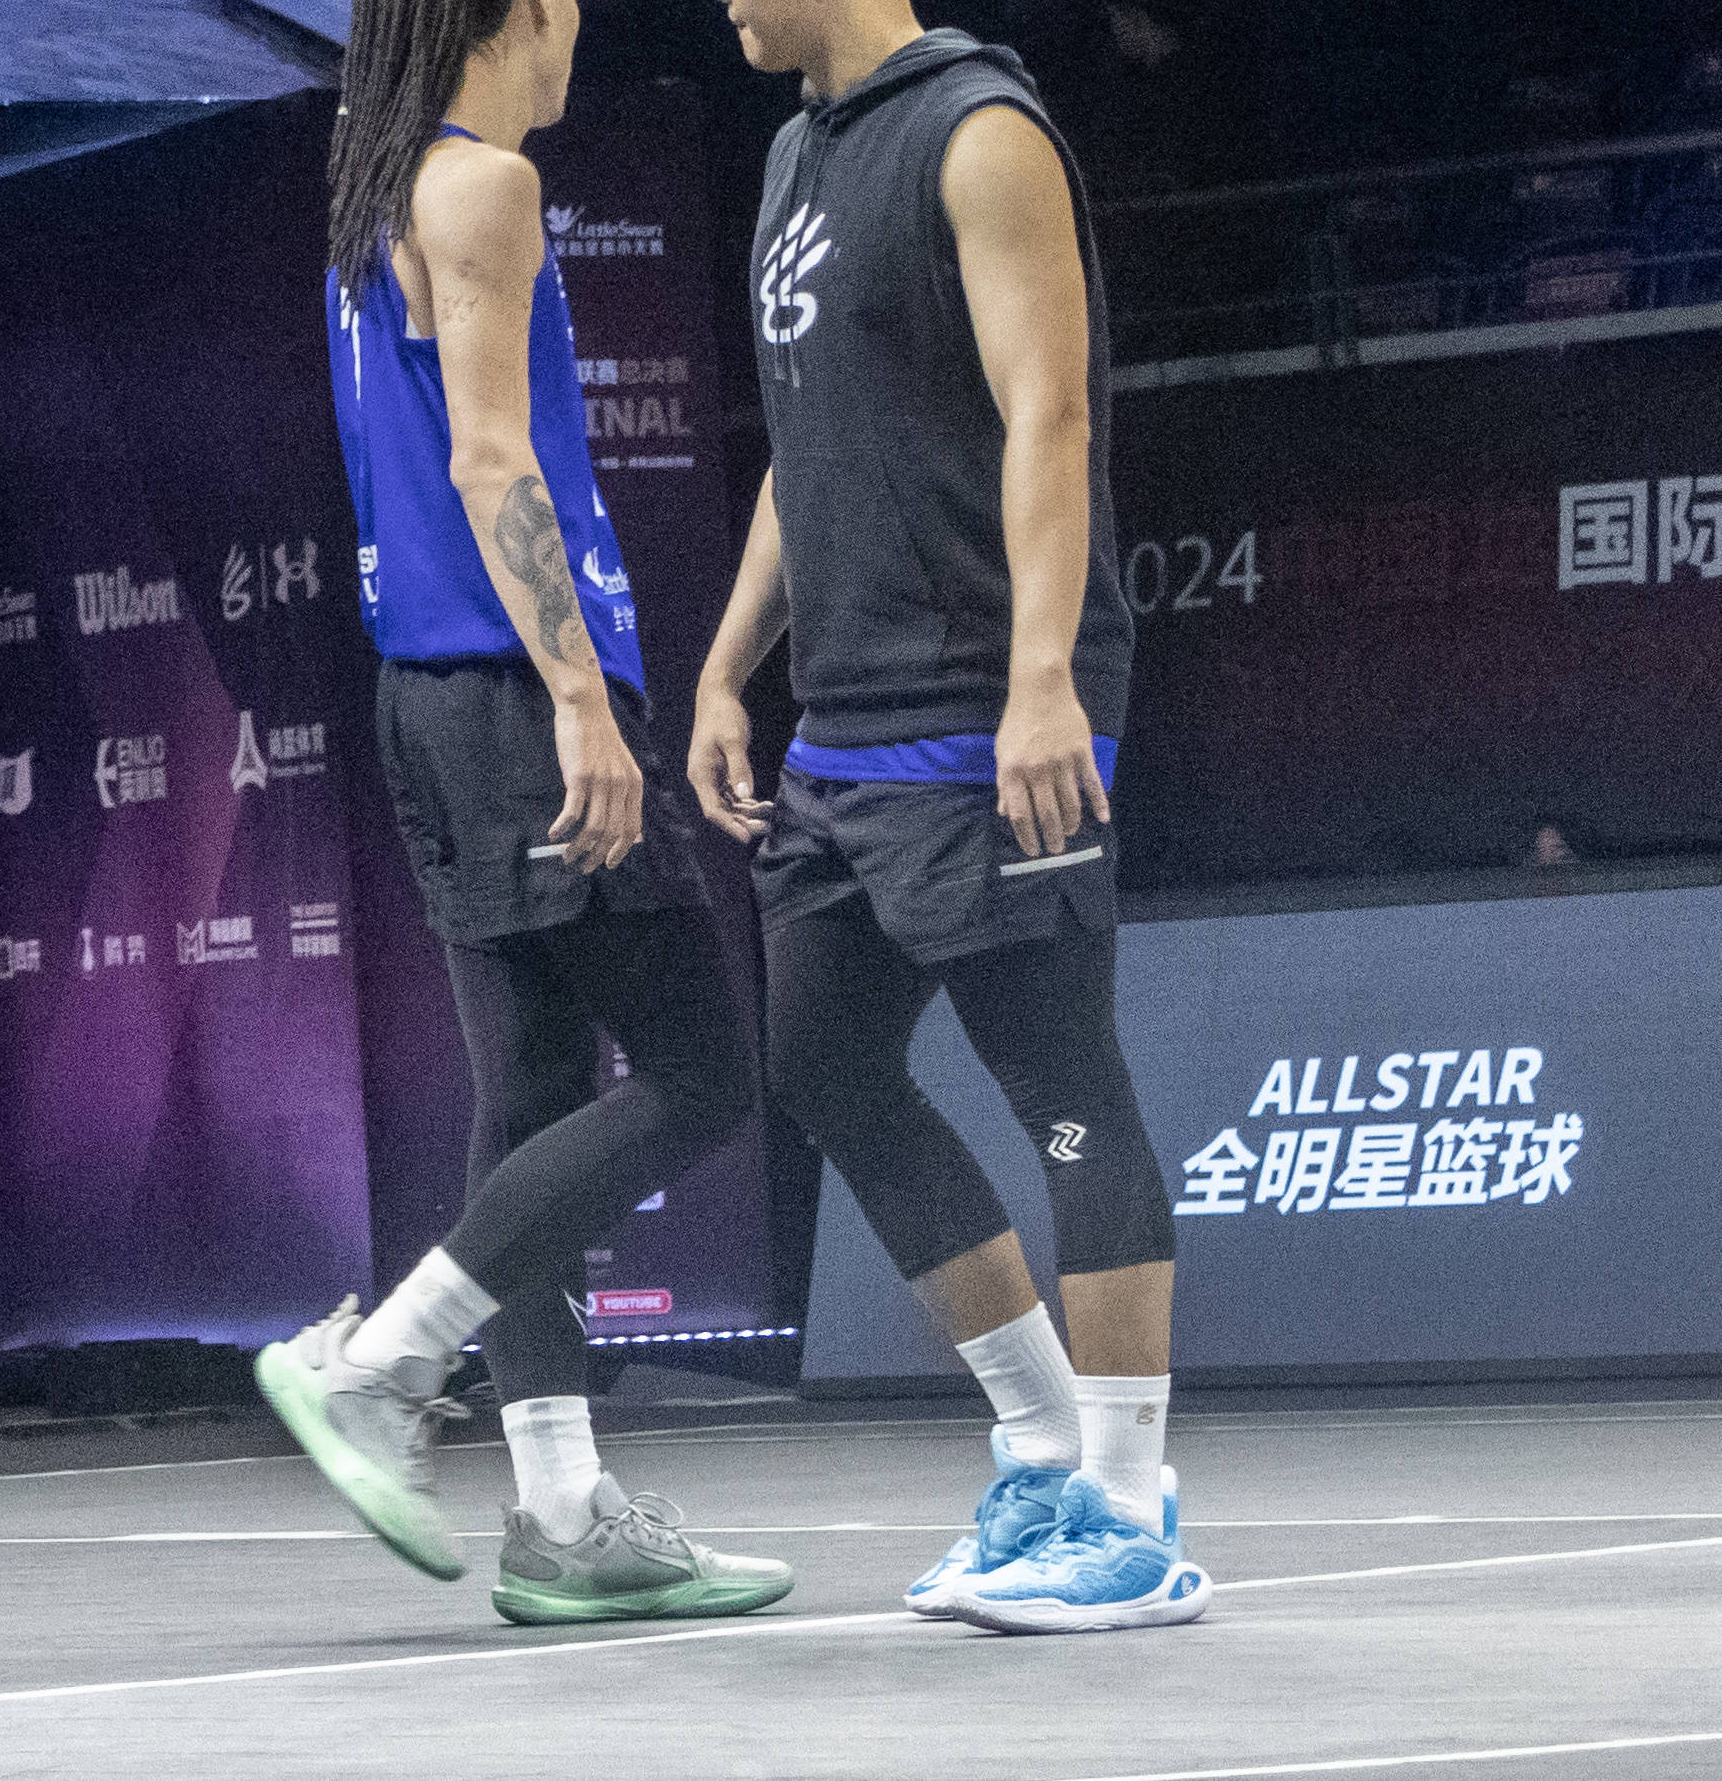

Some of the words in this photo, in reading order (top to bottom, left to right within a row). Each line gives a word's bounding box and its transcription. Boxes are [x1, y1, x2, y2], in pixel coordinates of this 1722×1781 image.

[584, 395, 694, 438] INAL
[1557, 473, 1722, 590] 国际
[73, 564, 183, 637] Wilson
[1123, 530, 1265, 616] 024
[1247, 1045, 1544, 1117] ALLSTAR
[1171, 1112, 1585, 1216] 全明星篮球
